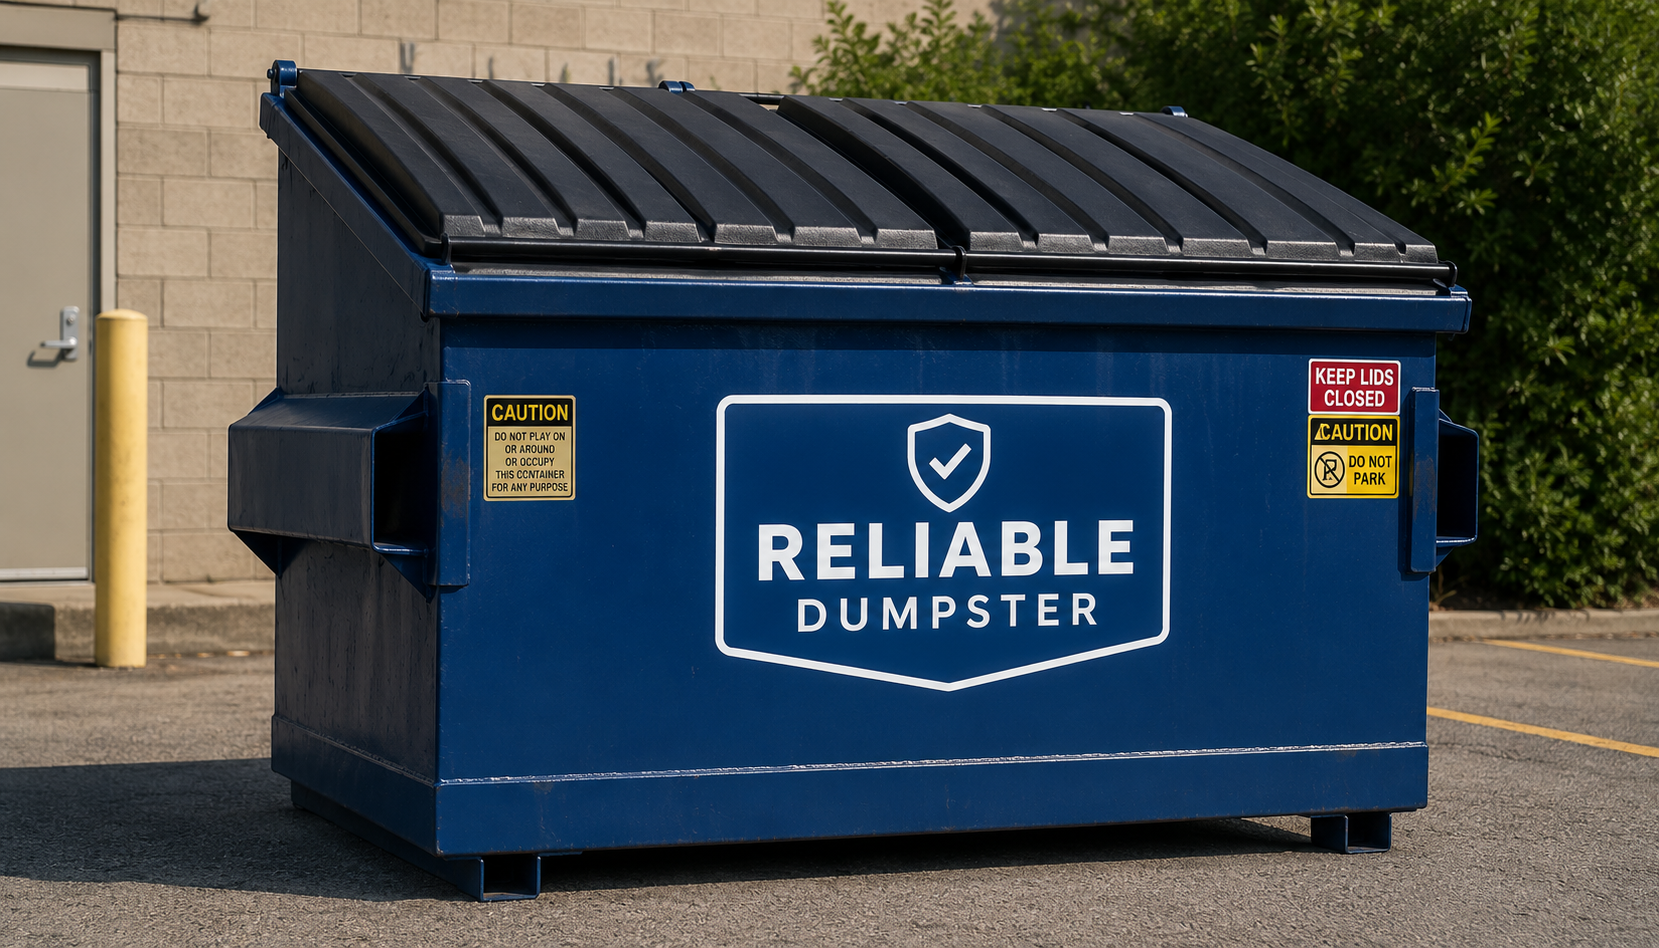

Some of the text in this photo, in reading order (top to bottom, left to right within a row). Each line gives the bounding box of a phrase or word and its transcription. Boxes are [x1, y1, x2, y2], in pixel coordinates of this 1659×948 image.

[1315, 367, 1394, 386] KEEP LIDS
[1324, 389, 1385, 407] CLOSED
[491, 404, 568, 421] CAUTION
[494, 431, 566, 441] DO NOT PLAY ON
[1320, 423, 1393, 441] CAUTION
[504, 444, 517, 454] OR
[505, 457, 555, 467] OR OCCUPY
[1349, 455, 1392, 468] DO NOT
[1354, 472, 1386, 485] PARK
[491, 482, 568, 492] FOR ANY PURPOSE
[758, 519, 1134, 582] RELIABLE
[797, 592, 1098, 632] DUMPSTER
